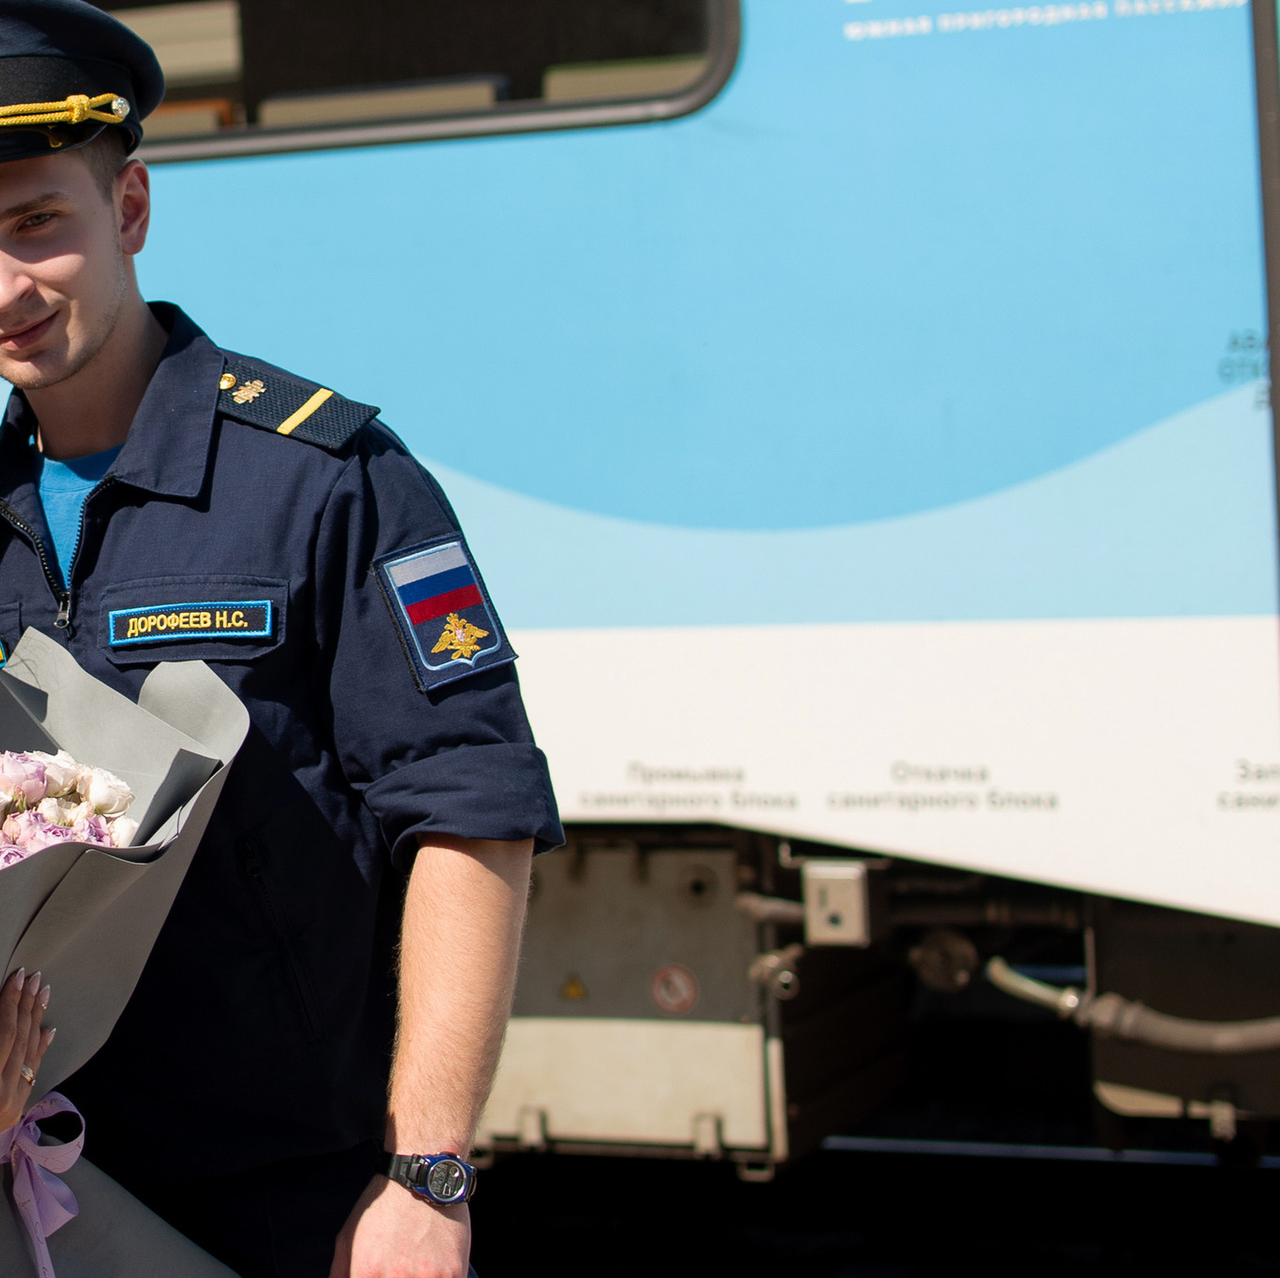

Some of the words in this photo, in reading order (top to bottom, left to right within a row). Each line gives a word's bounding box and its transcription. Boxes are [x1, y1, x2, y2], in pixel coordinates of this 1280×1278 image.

[127, 612, 212, 637] ДОРОФЕЕВ
[215, 610, 248, 629] Н.С.
[890, 761, 990, 784] Откачка
[826, 791, 979, 812] санитарного
[985, 788, 1060, 812] блока
